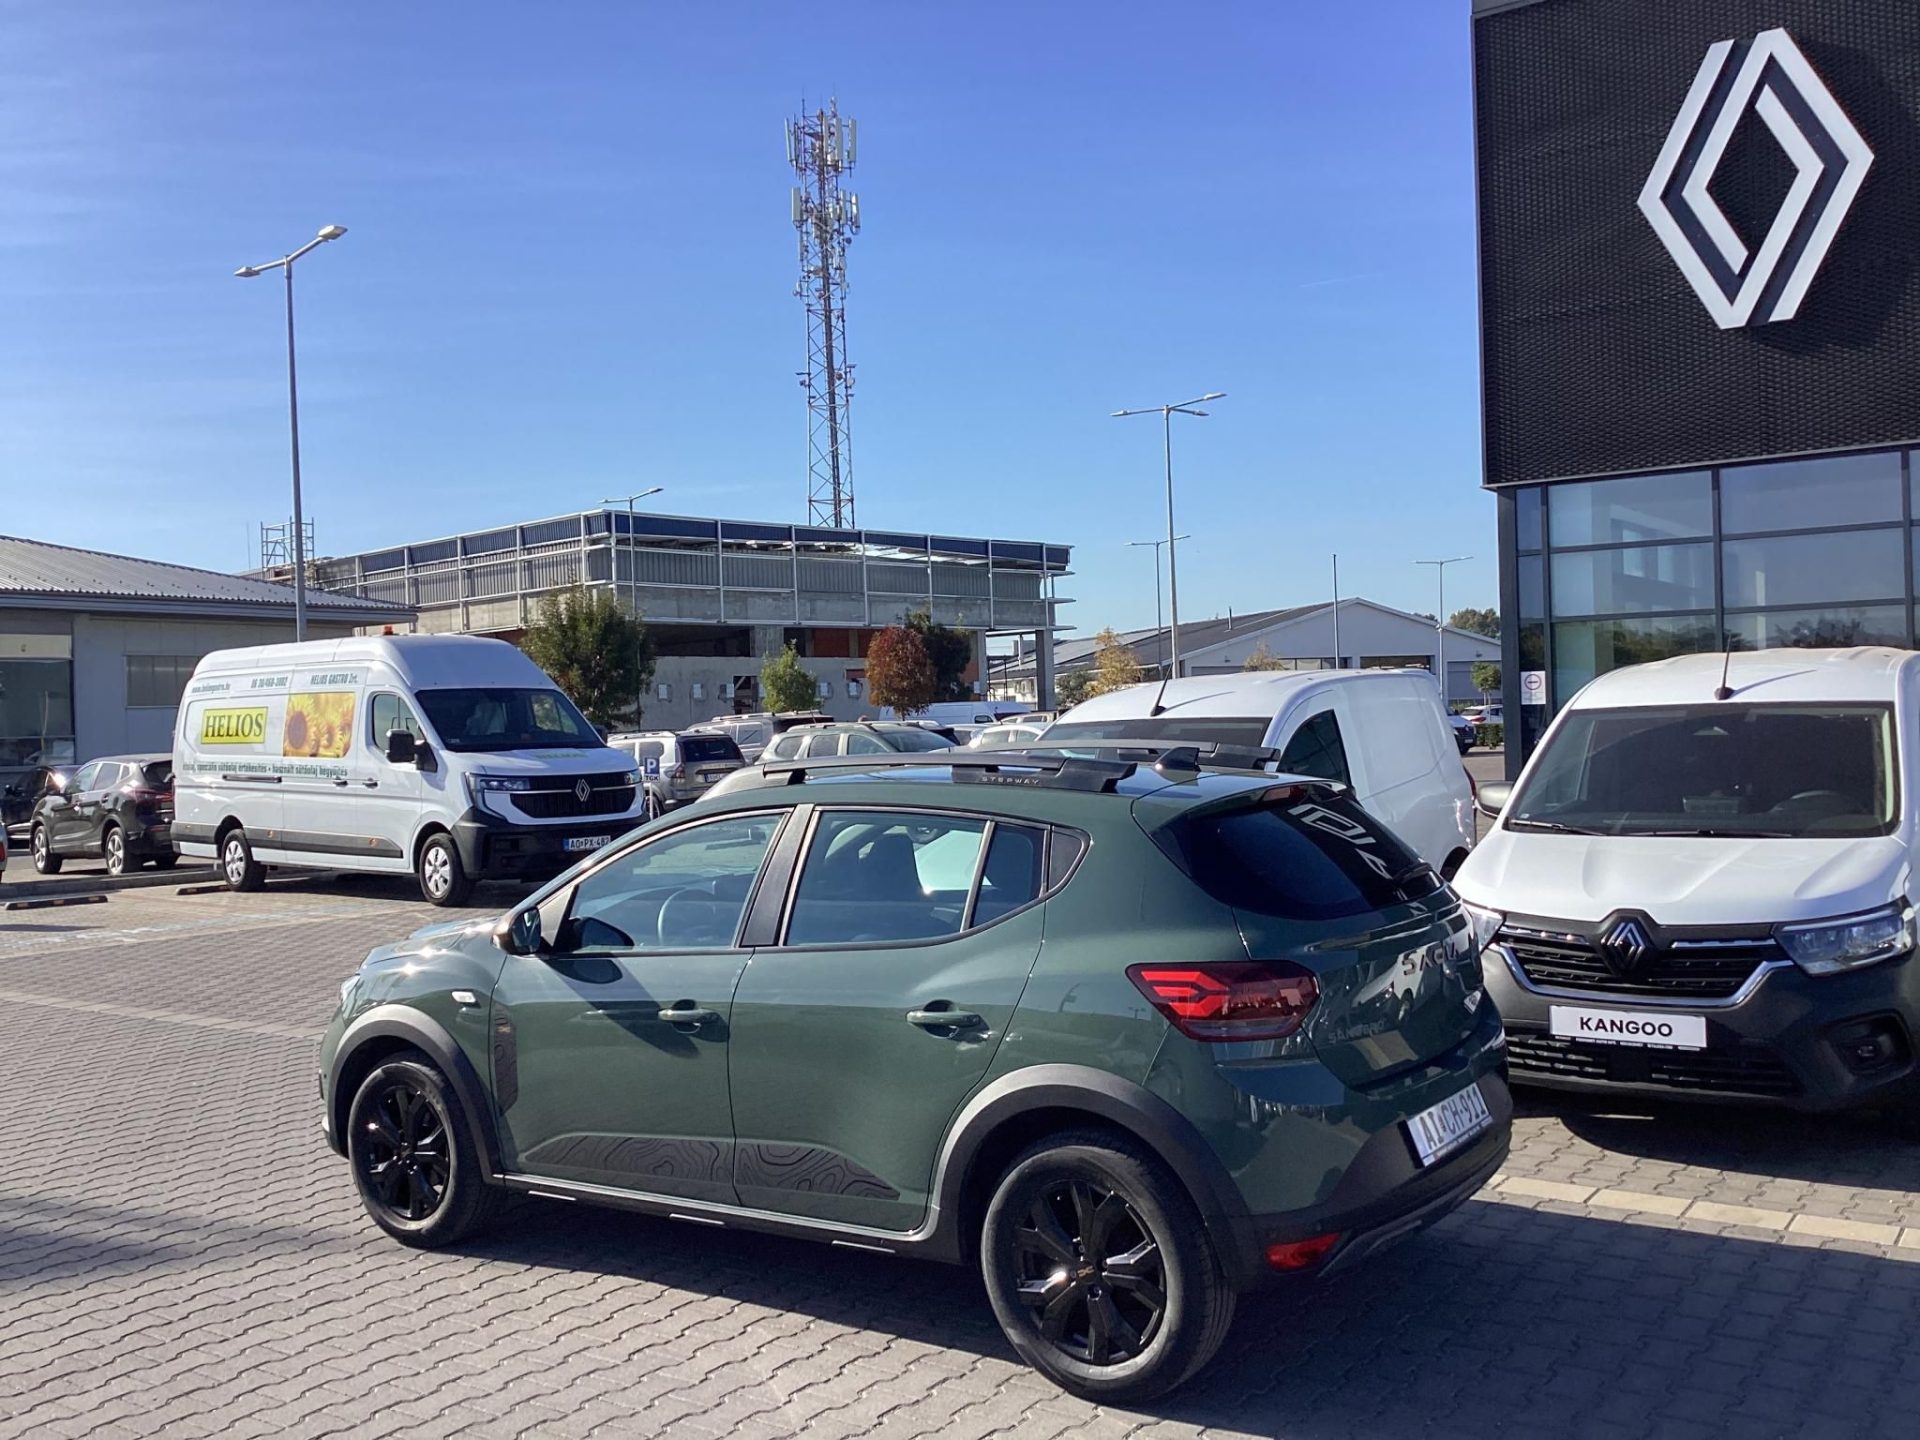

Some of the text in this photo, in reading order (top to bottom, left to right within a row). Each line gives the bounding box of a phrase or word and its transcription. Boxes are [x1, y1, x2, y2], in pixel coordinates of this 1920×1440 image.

[310, 674, 328, 685] HELIOS
[328, 673, 348, 684] GASTRO
[204, 713, 264, 738] HELIOS
[647, 758, 656, 773] P
[1579, 1016, 1673, 1037] KANGOO
